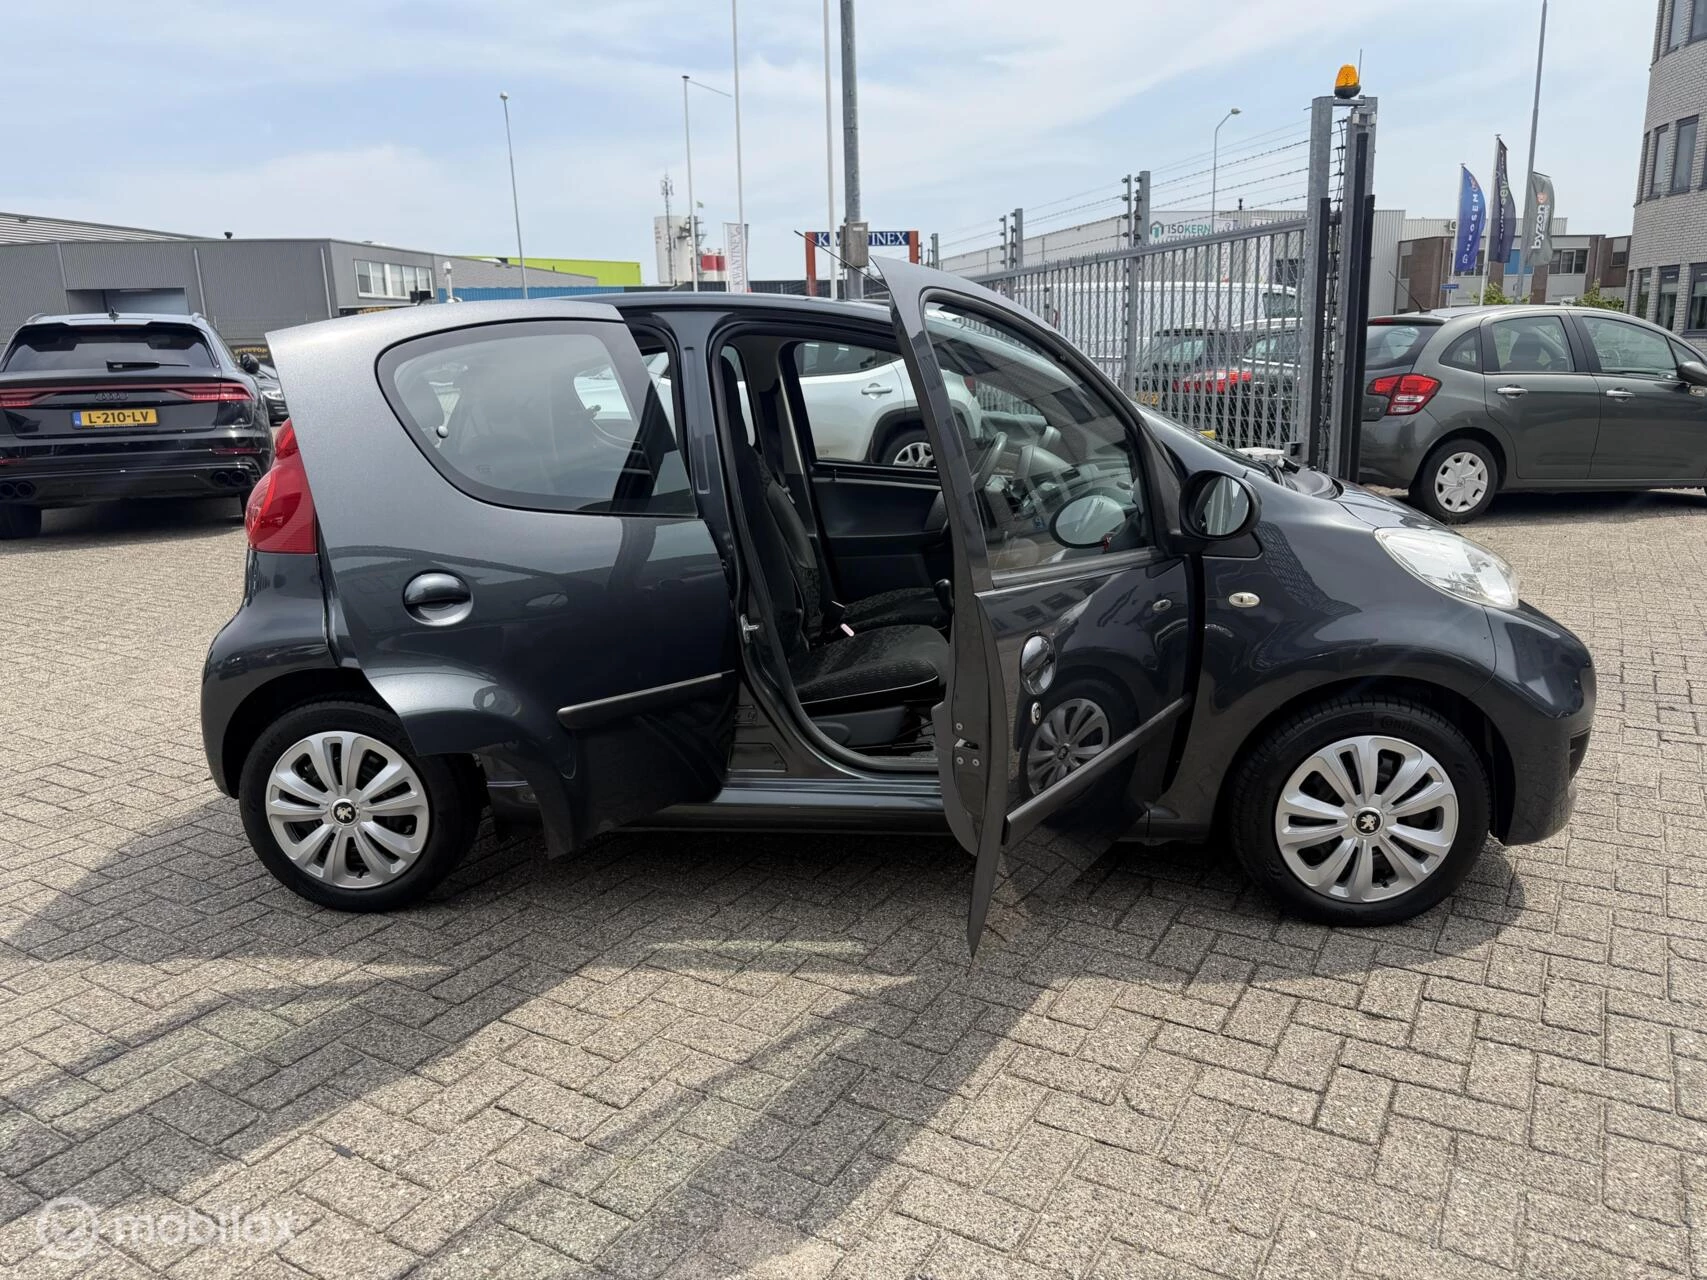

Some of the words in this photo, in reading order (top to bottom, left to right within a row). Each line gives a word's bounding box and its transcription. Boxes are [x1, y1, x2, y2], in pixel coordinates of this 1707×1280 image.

[1167, 224, 1211, 234] ISOKERN
[1531, 204, 1545, 249] byzon
[818, 232, 906, 246] KINEX
[88, 411, 149, 424] L-210-LV
